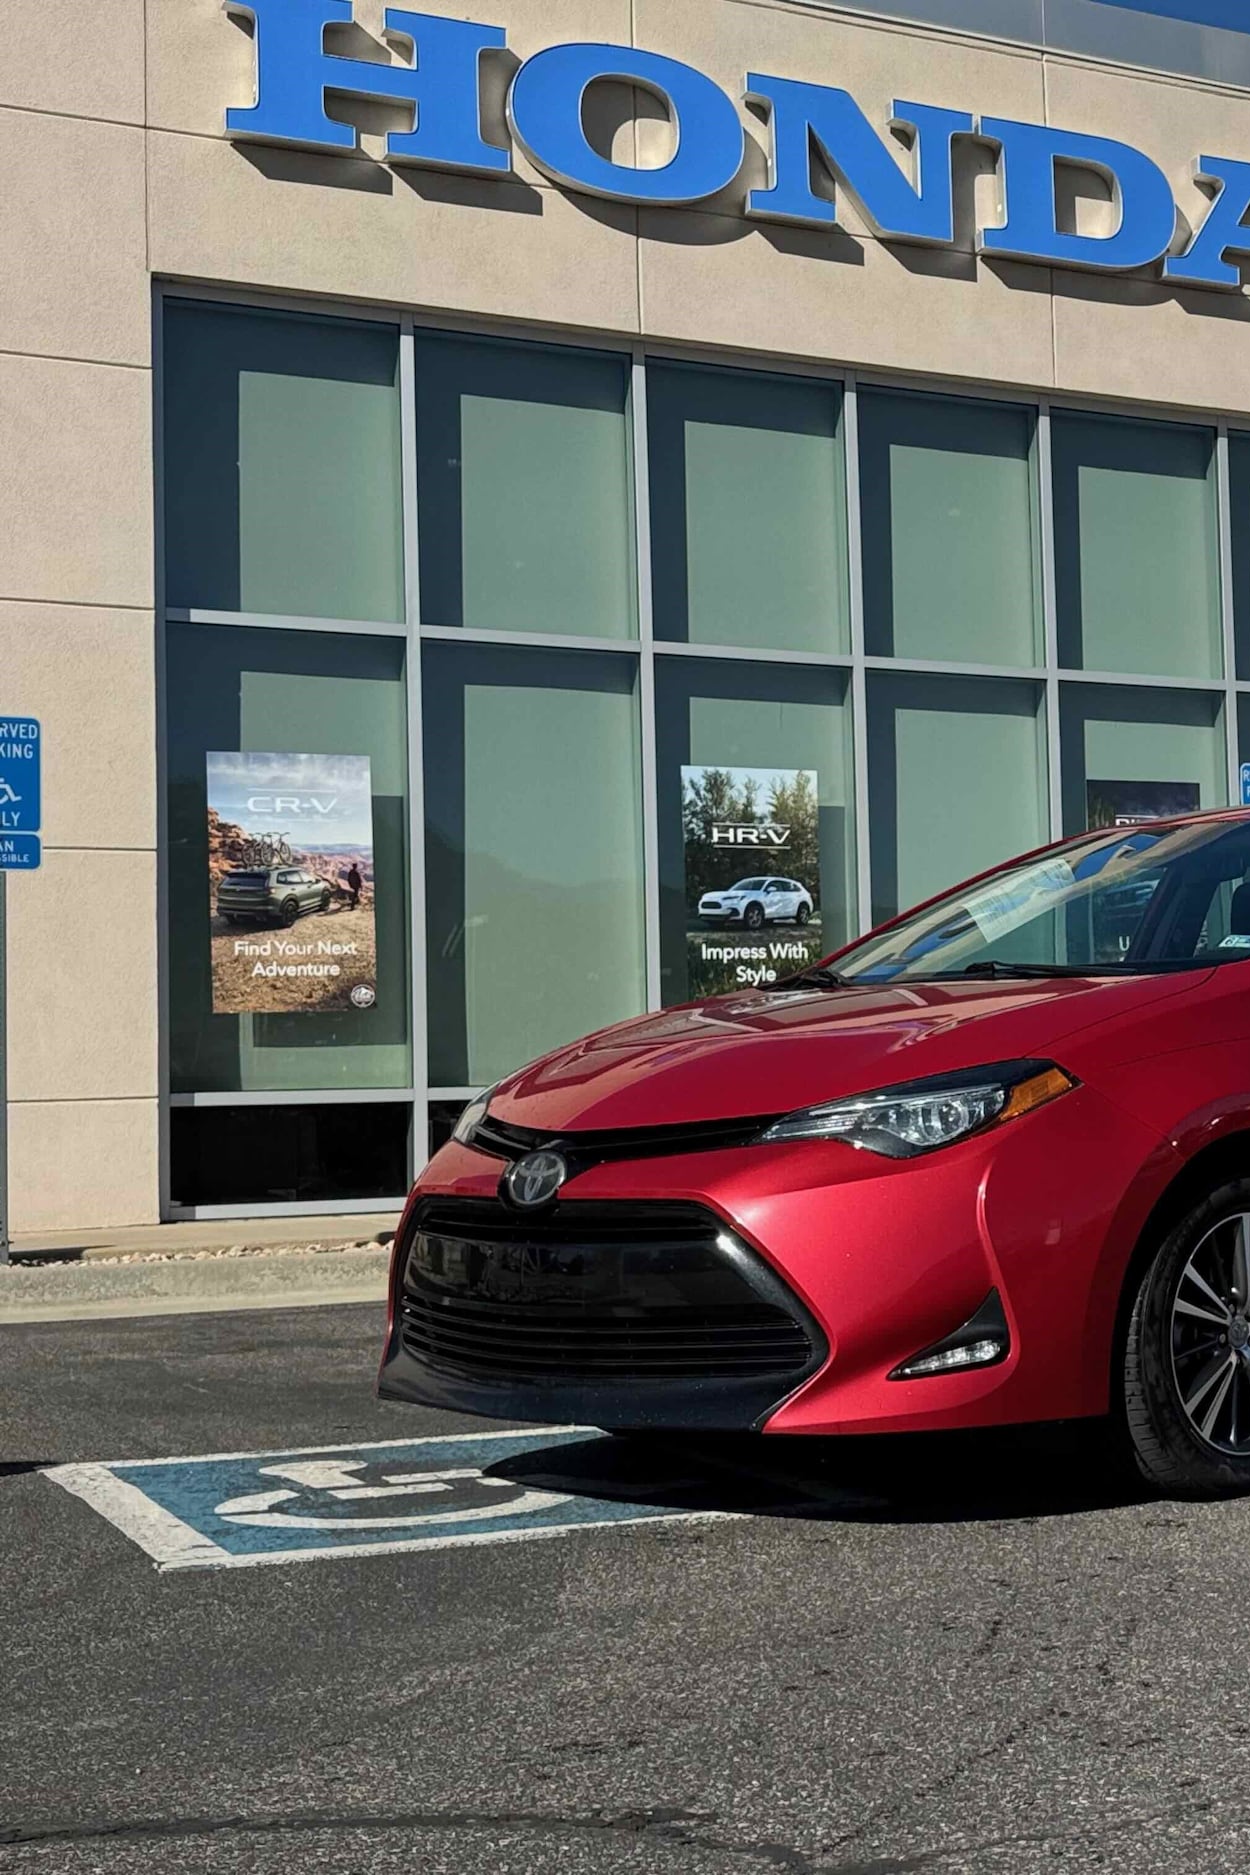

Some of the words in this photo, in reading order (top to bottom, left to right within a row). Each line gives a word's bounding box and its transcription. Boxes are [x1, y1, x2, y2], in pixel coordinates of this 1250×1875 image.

[0, 723, 38, 739] RVED
[0, 743, 34, 759] KING
[247, 796, 338, 813] CR-V
[2, 811, 21, 827] LY
[712, 827, 791, 844] HR-V
[234, 940, 272, 956] Find
[276, 940, 314, 956] Your
[317, 940, 358, 956] Next
[702, 943, 767, 962] Impress
[769, 943, 808, 960] With
[251, 961, 341, 977] Adventure
[736, 966, 777, 986] Style
